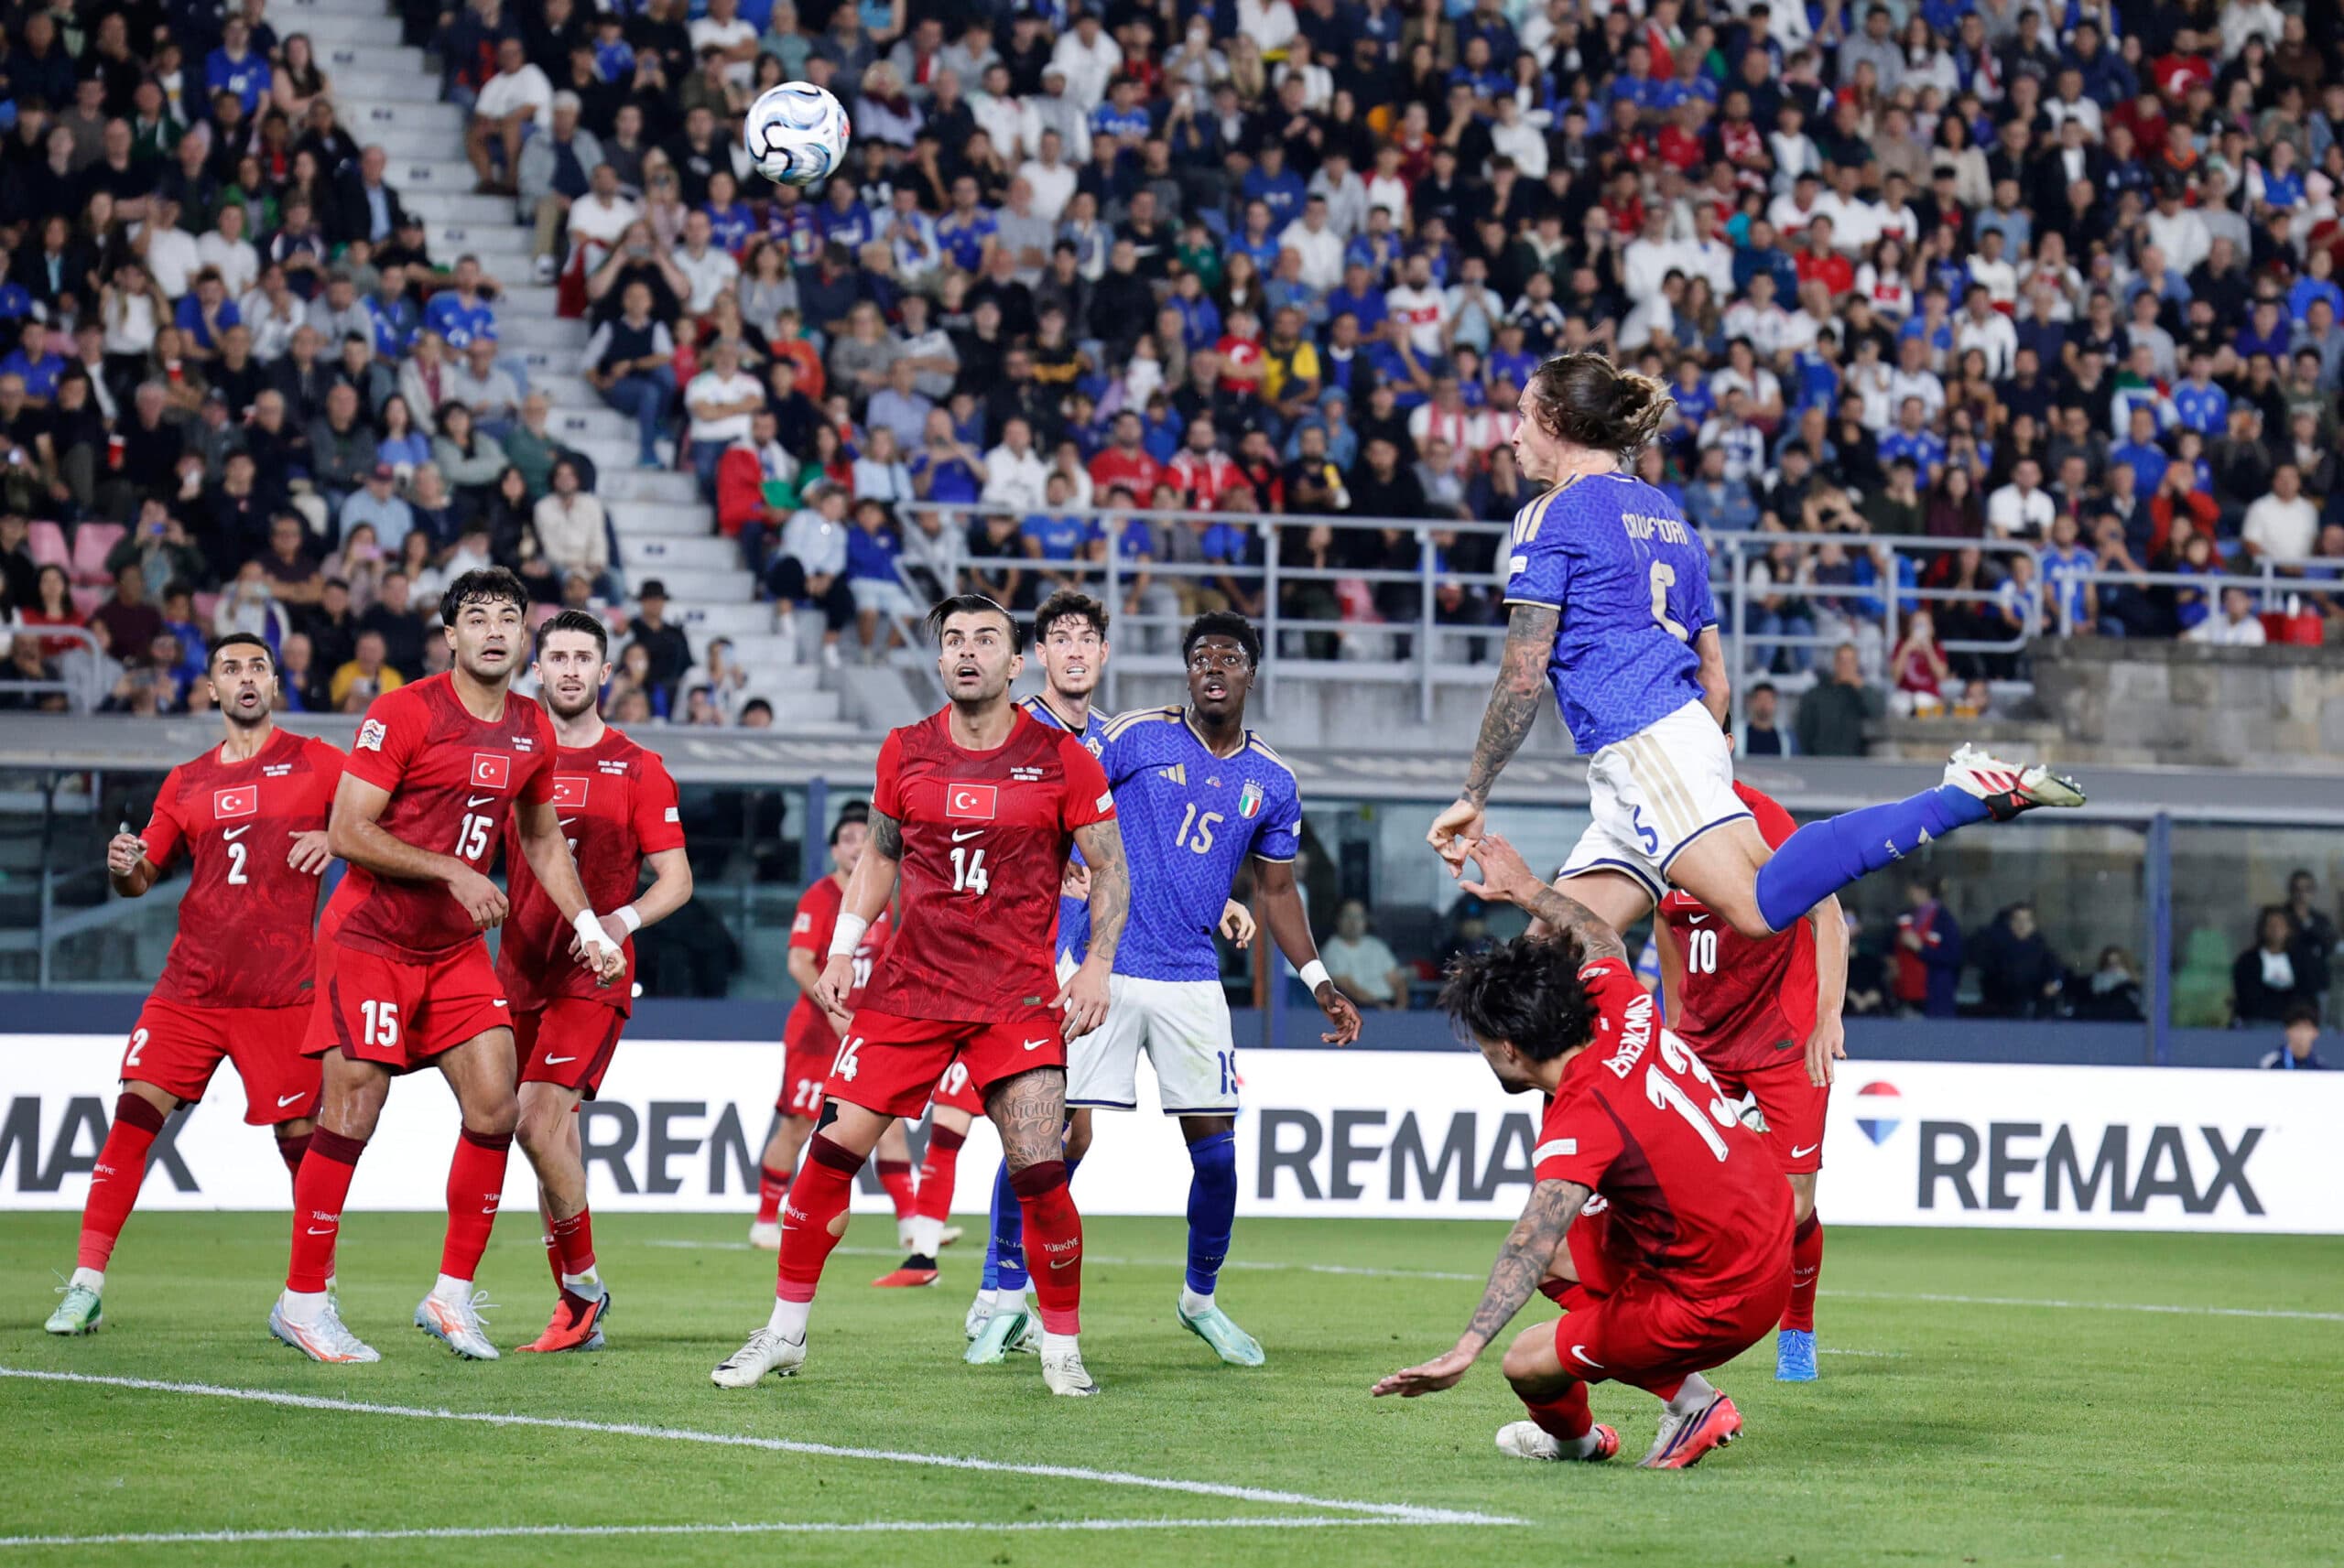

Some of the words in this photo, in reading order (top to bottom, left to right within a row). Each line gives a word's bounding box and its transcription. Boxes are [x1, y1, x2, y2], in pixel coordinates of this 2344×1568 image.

[455, 813, 494, 860] 15
[1176, 803, 1223, 854] 15
[1633, 805, 1658, 854] 5
[228, 842, 247, 885] 2
[950, 848, 988, 895] 14
[1688, 929, 1717, 974] 10
[125, 1028, 149, 1066] 2
[361, 1000, 398, 1047] 15
[830, 1034, 864, 1082] 14
[939, 1062, 968, 1097] 19
[793, 1078, 824, 1111] 21
[1645, 1028, 1737, 1162] 13
[1257, 1108, 1536, 1201] REMA
[1917, 1120, 2266, 1216] REMAX
[1043, 1237, 1079, 1252] TÜRKİYE
